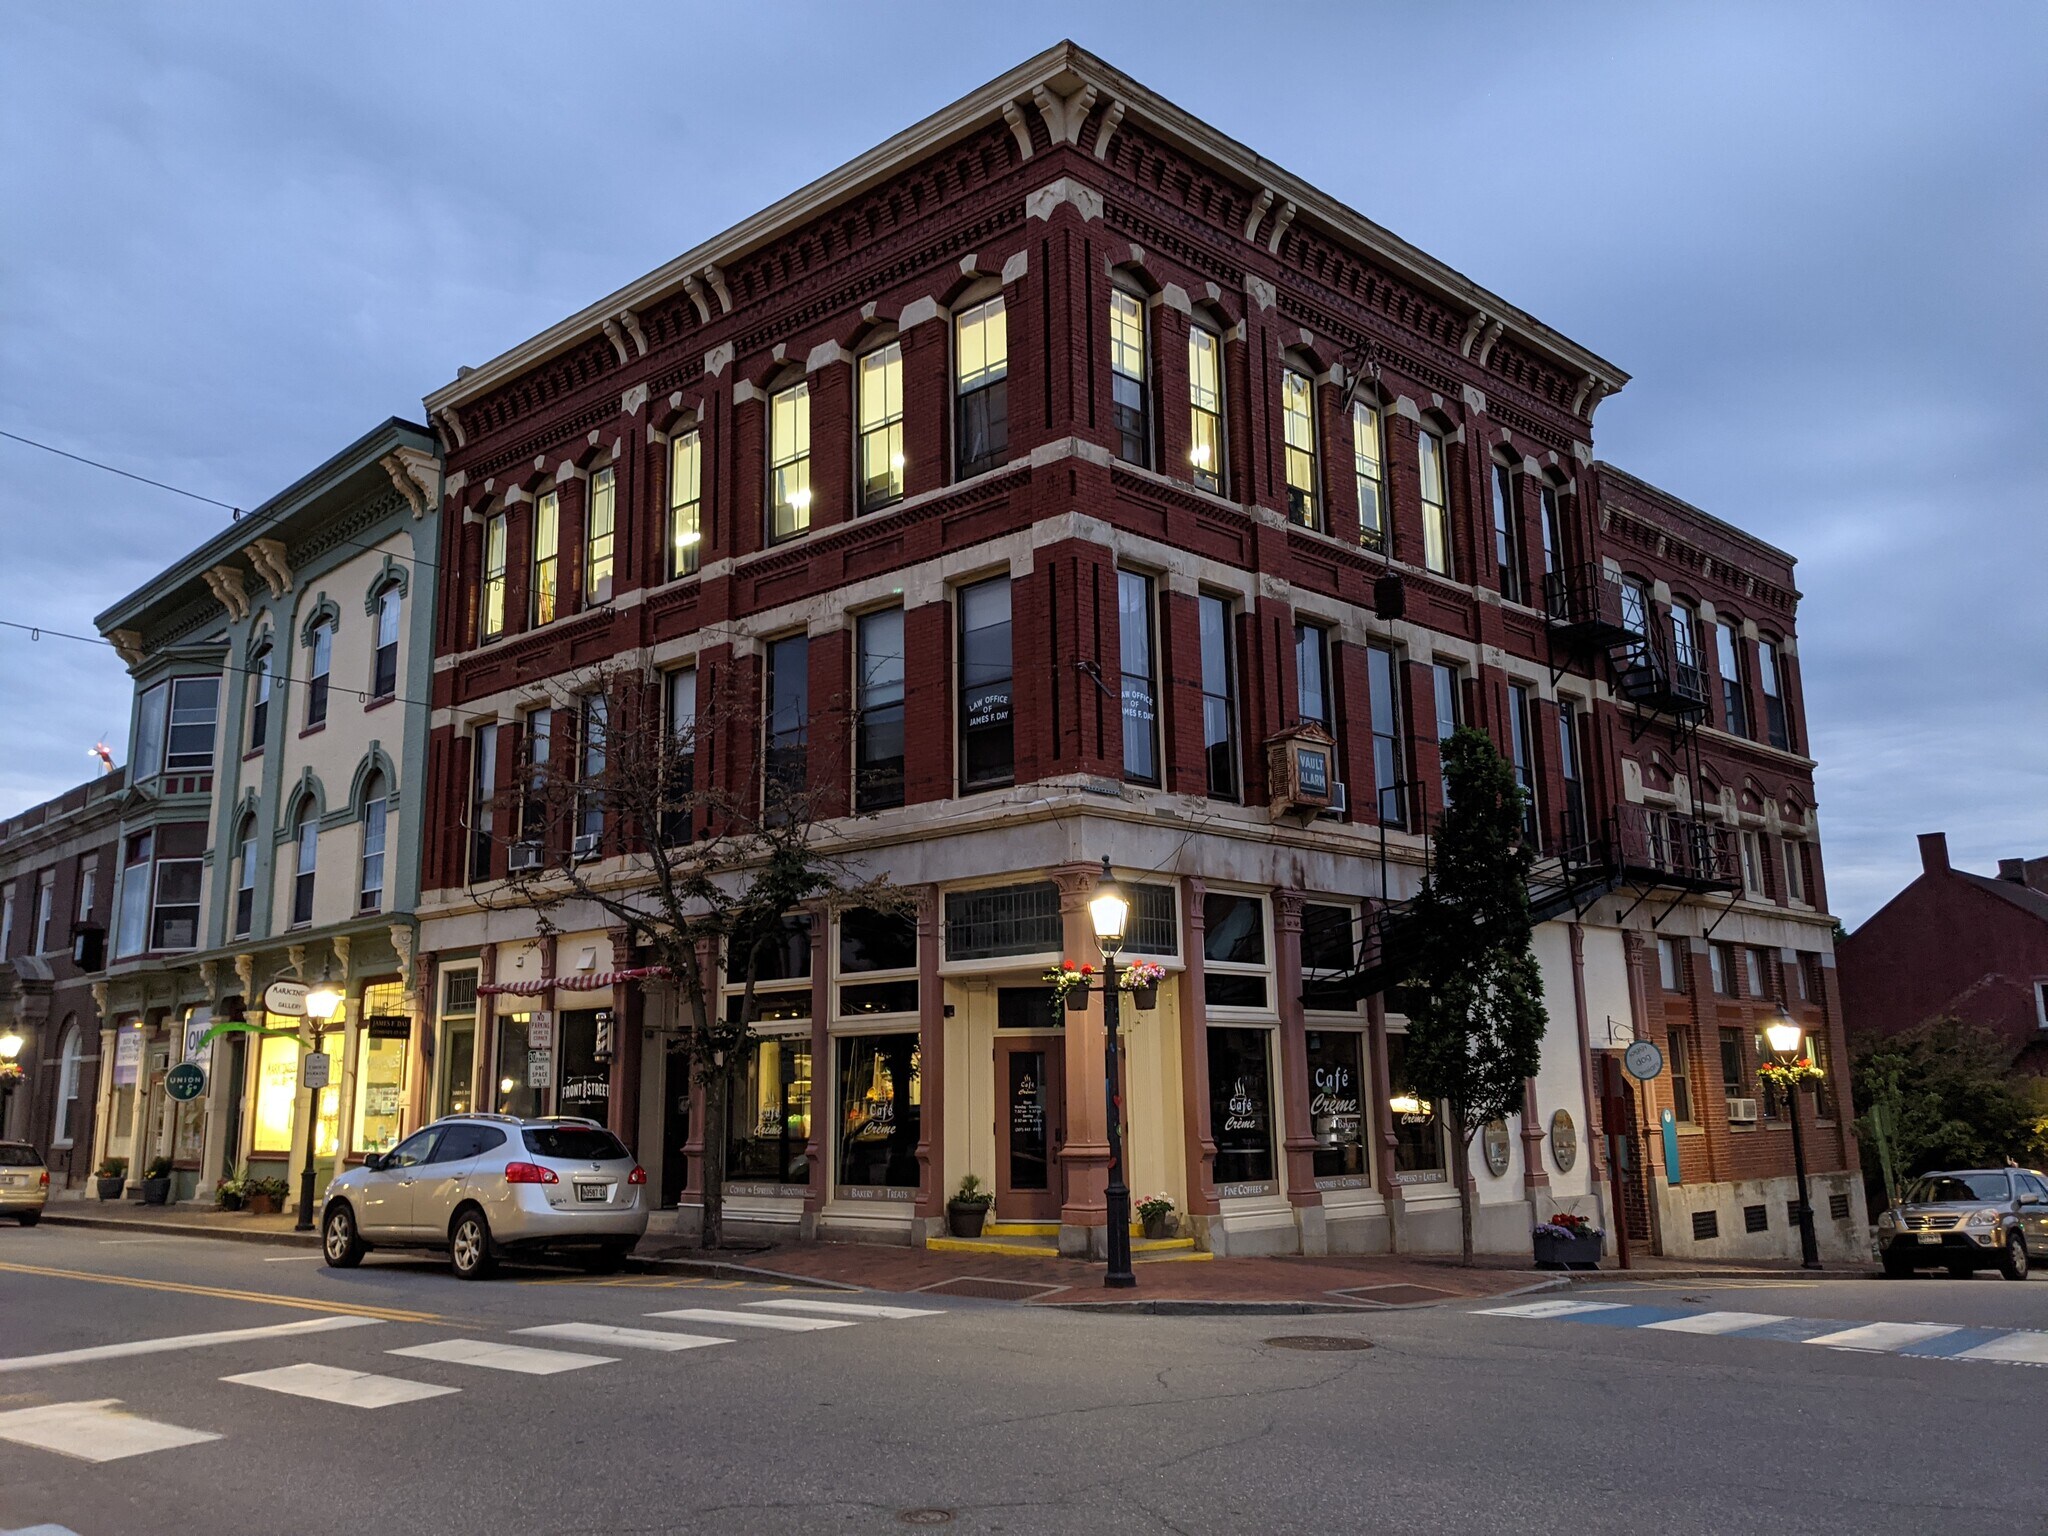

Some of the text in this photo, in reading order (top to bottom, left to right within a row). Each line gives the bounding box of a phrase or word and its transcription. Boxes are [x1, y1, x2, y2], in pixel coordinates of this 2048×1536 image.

[969, 695, 1008, 712] LAW OFFICE
[1121, 690, 1153, 706] AW OFFICE
[1130, 700, 1139, 708] OF
[982, 705, 992, 713] OF
[1137, 709, 1143, 719] F.
[1143, 710, 1154, 721] DAY
[969, 711, 1009, 727] JAMES F. DAY
[1300, 756, 1324, 771] VAULT
[1301, 772, 1326, 788] ALARM
[278, 1001, 301, 1010] GALLERY
[1315, 1067, 1349, 1093] Café
[562, 1082, 610, 1099] FRONT STREET
[869, 1103, 894, 1120] Café
[1229, 1098, 1252, 1115] Café
[1310, 1093, 1357, 1115] Crème
[863, 1122, 897, 1136] Crème
[1224, 1116, 1256, 1131] Crème
[851, 1188, 908, 1199] BAKERY TREATS
[1224, 1184, 1262, 1196] FINE COFFEES
